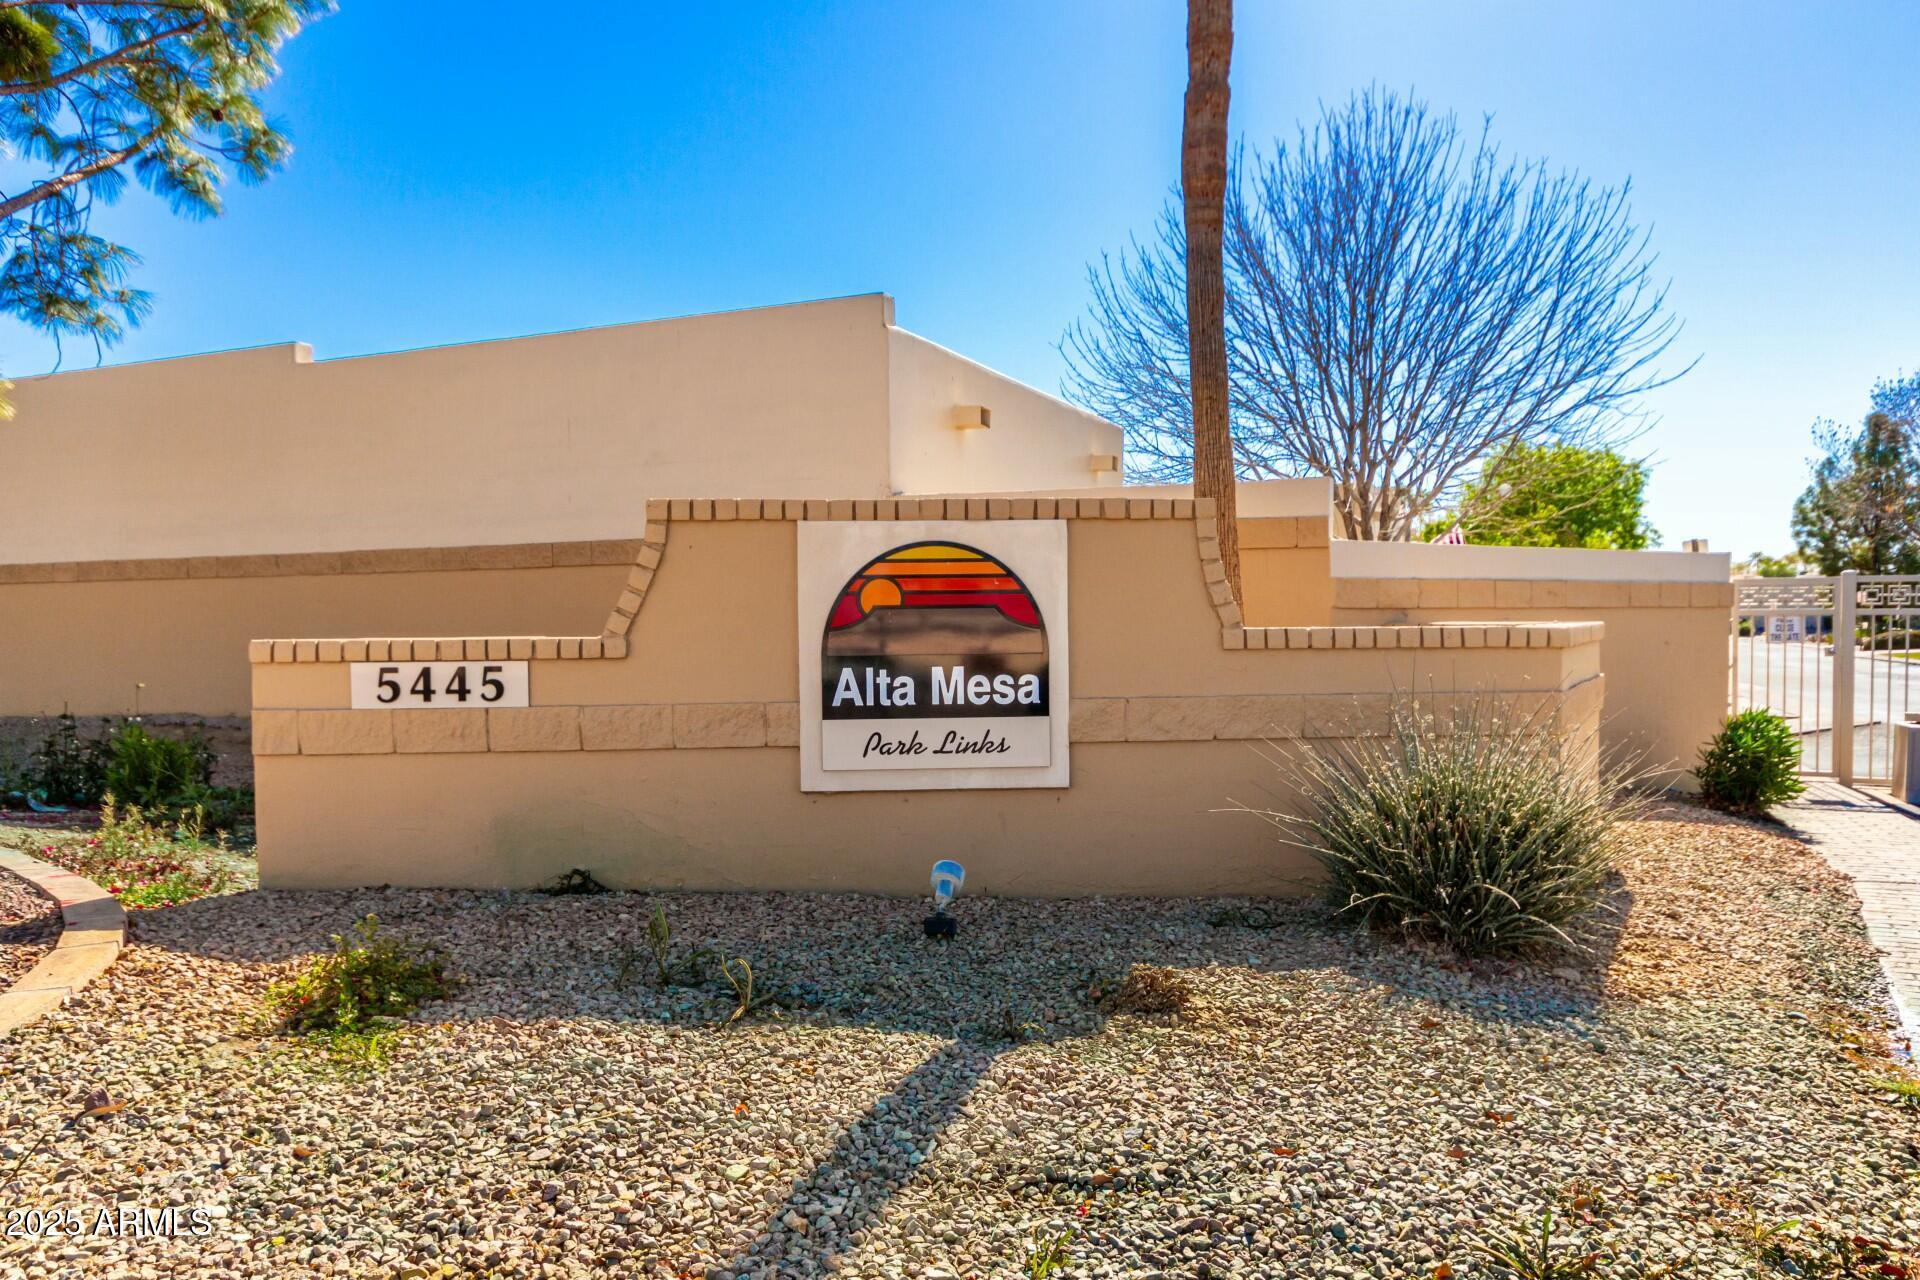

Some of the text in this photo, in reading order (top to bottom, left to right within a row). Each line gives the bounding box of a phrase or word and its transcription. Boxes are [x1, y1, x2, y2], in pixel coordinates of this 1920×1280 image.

[376, 666, 505, 703] 5445
[832, 666, 1041, 707] Alta Mesa
[862, 729, 1011, 758] Park Links
